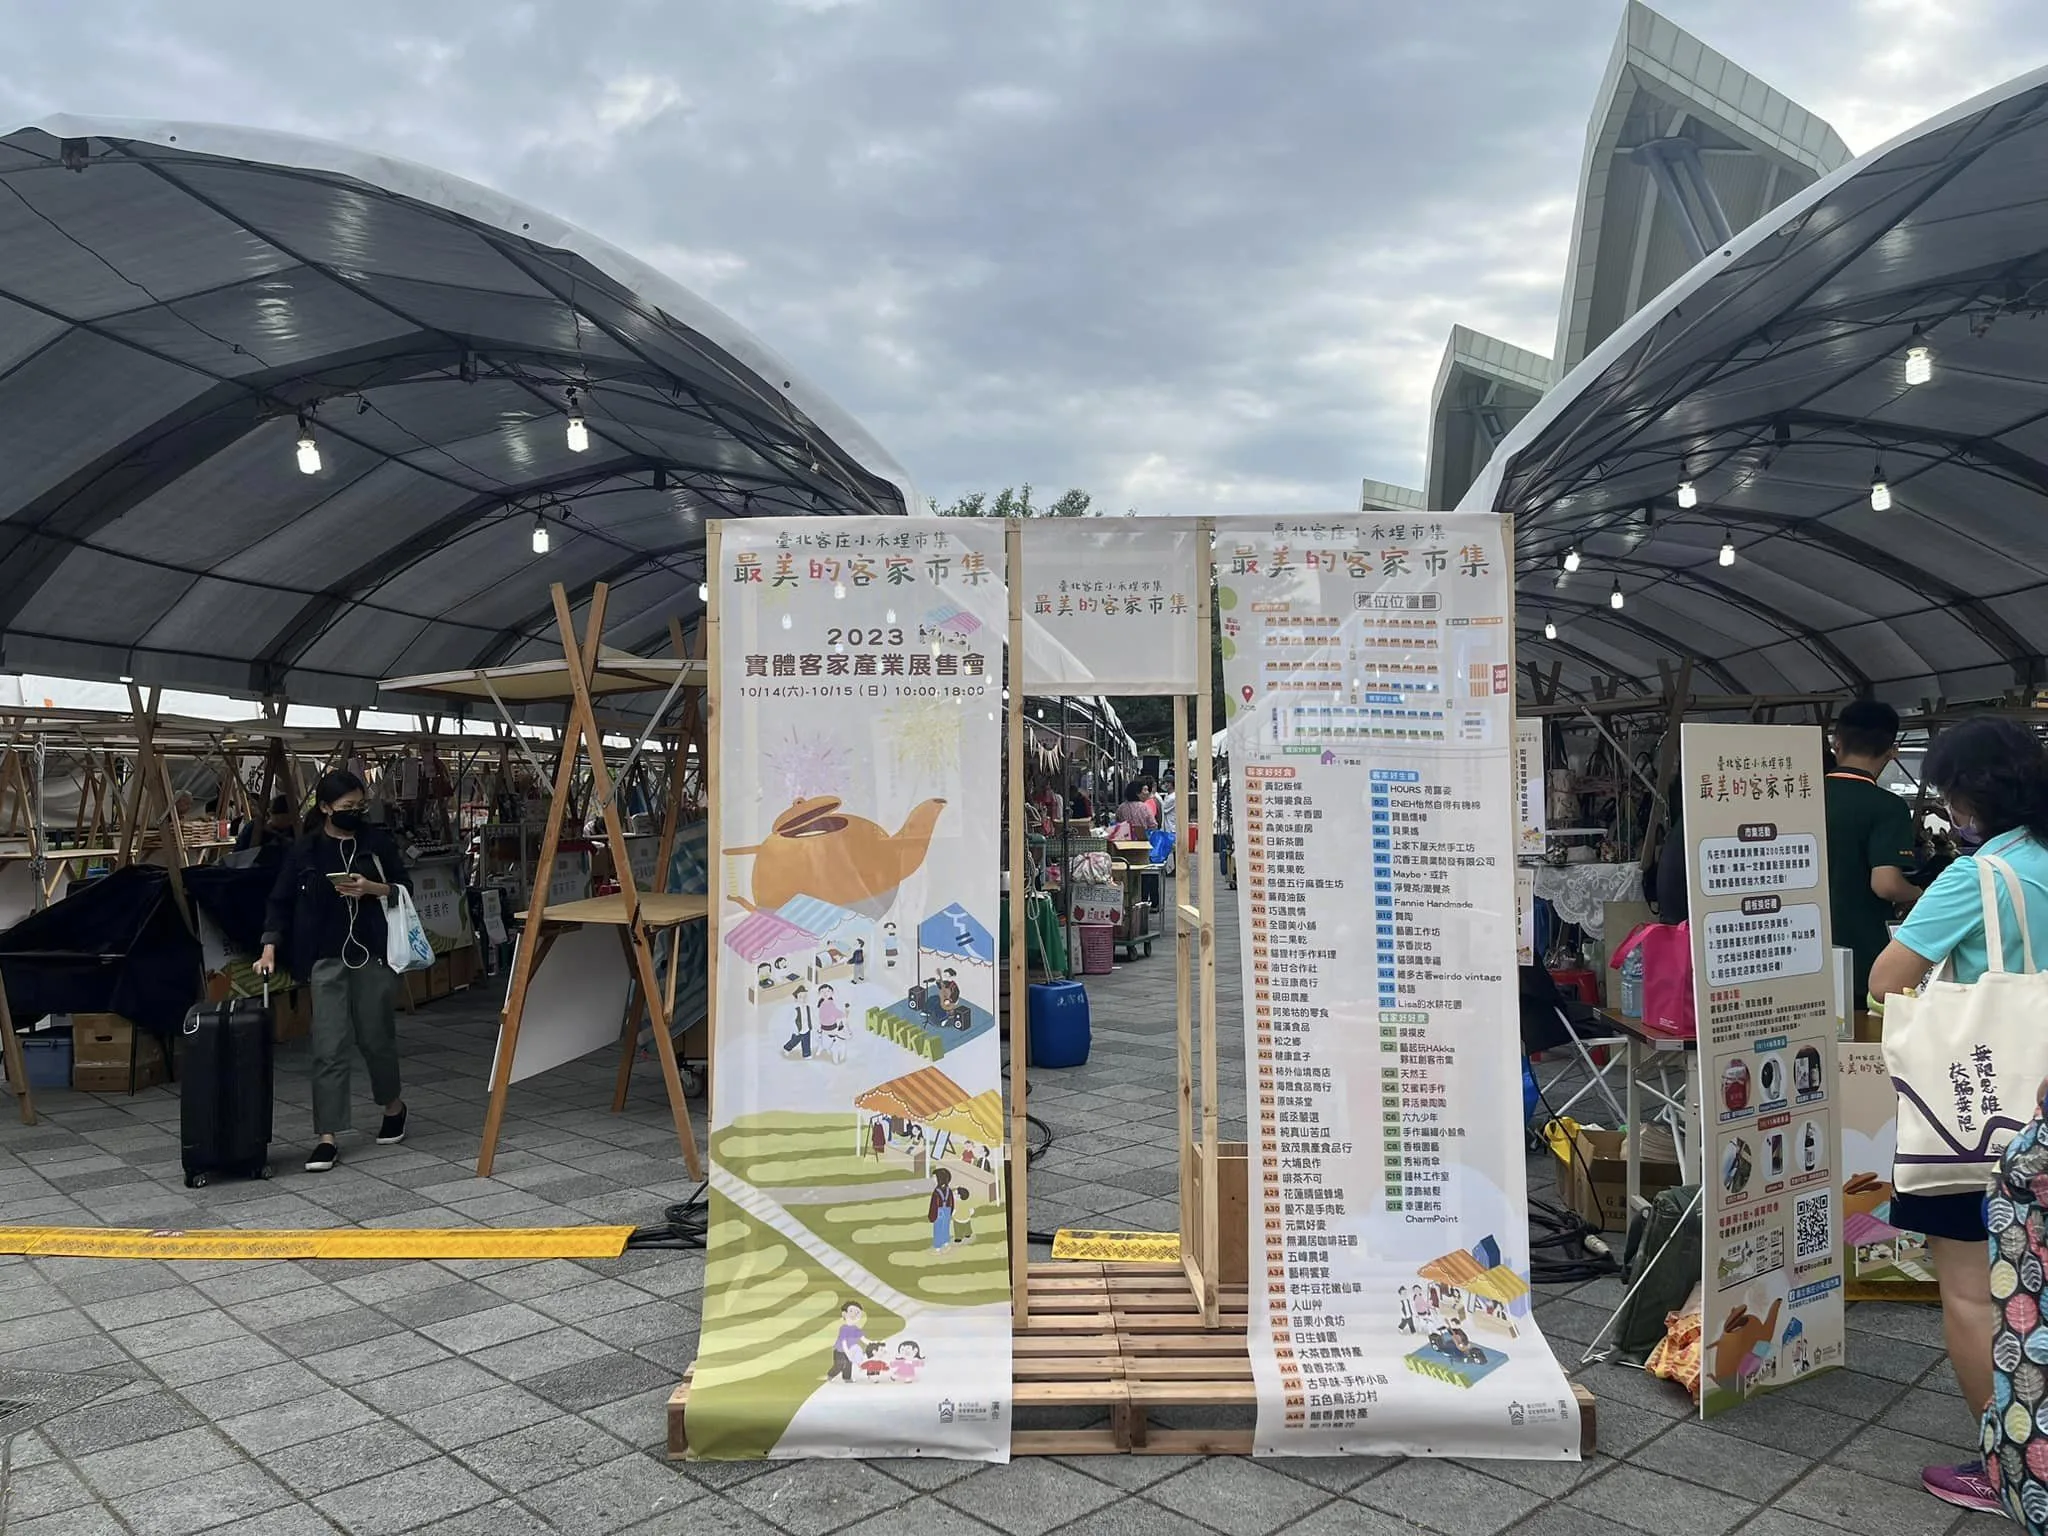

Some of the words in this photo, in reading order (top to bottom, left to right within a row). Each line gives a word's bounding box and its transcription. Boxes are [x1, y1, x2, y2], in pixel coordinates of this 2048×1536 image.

[733, 552, 991, 587] 最美的客家市集
[1231, 544, 1490, 578] 最美的客家市集
[1034, 592, 1189, 616] 最美的客家市集
[827, 628, 904, 646] 2023
[745, 653, 985, 677] 實體客家產業展售會
[1390, 785, 1422, 794] HOURS
[1700, 772, 1811, 802] 最美的客家市集
[1426, 900, 1473, 910] Handmade
[1464, 973, 1502, 983] vintage
[1405, 1214, 1459, 1224] CharmPoint
